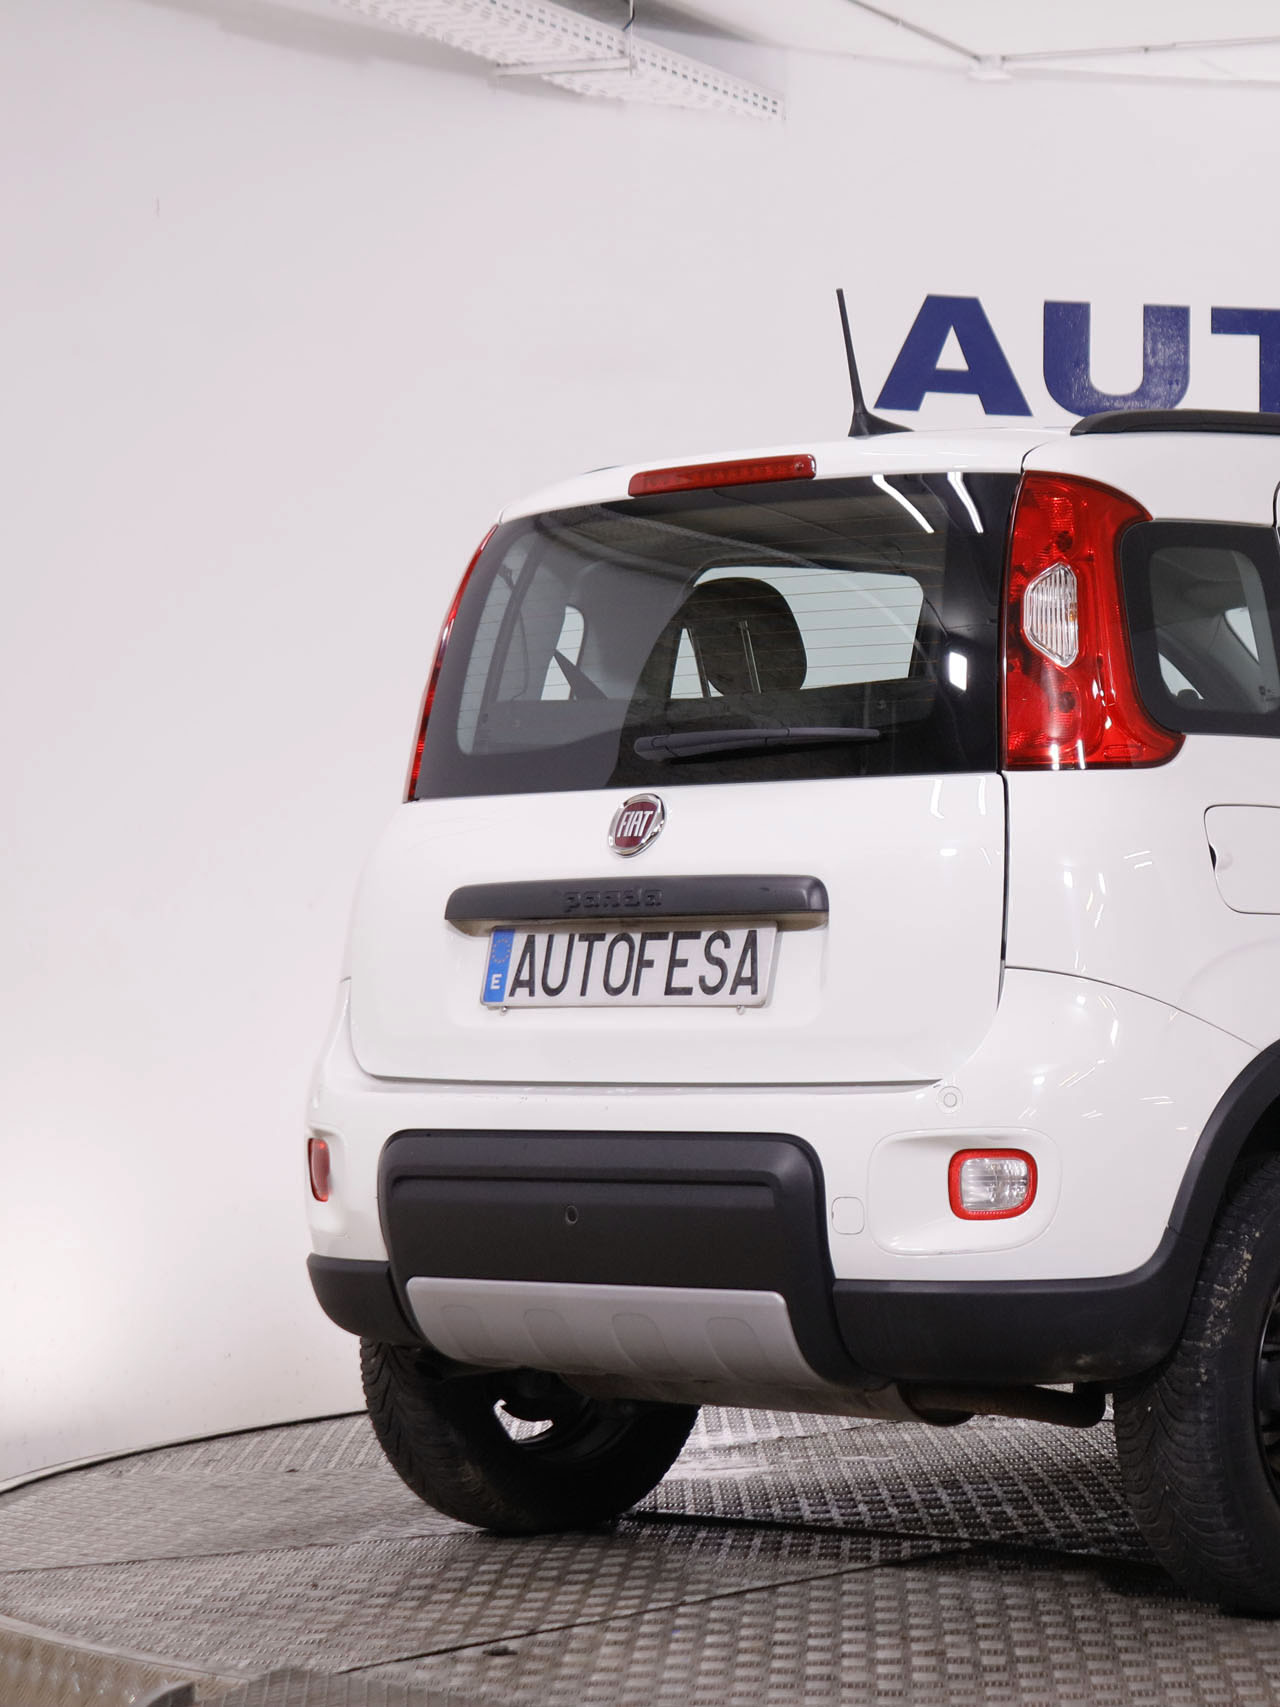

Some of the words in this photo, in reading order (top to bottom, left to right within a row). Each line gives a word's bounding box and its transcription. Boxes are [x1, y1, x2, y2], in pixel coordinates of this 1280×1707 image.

[617, 810, 654, 838] FIAT
[490, 974, 502, 989] E
[509, 930, 759, 997] AUTOFESA
